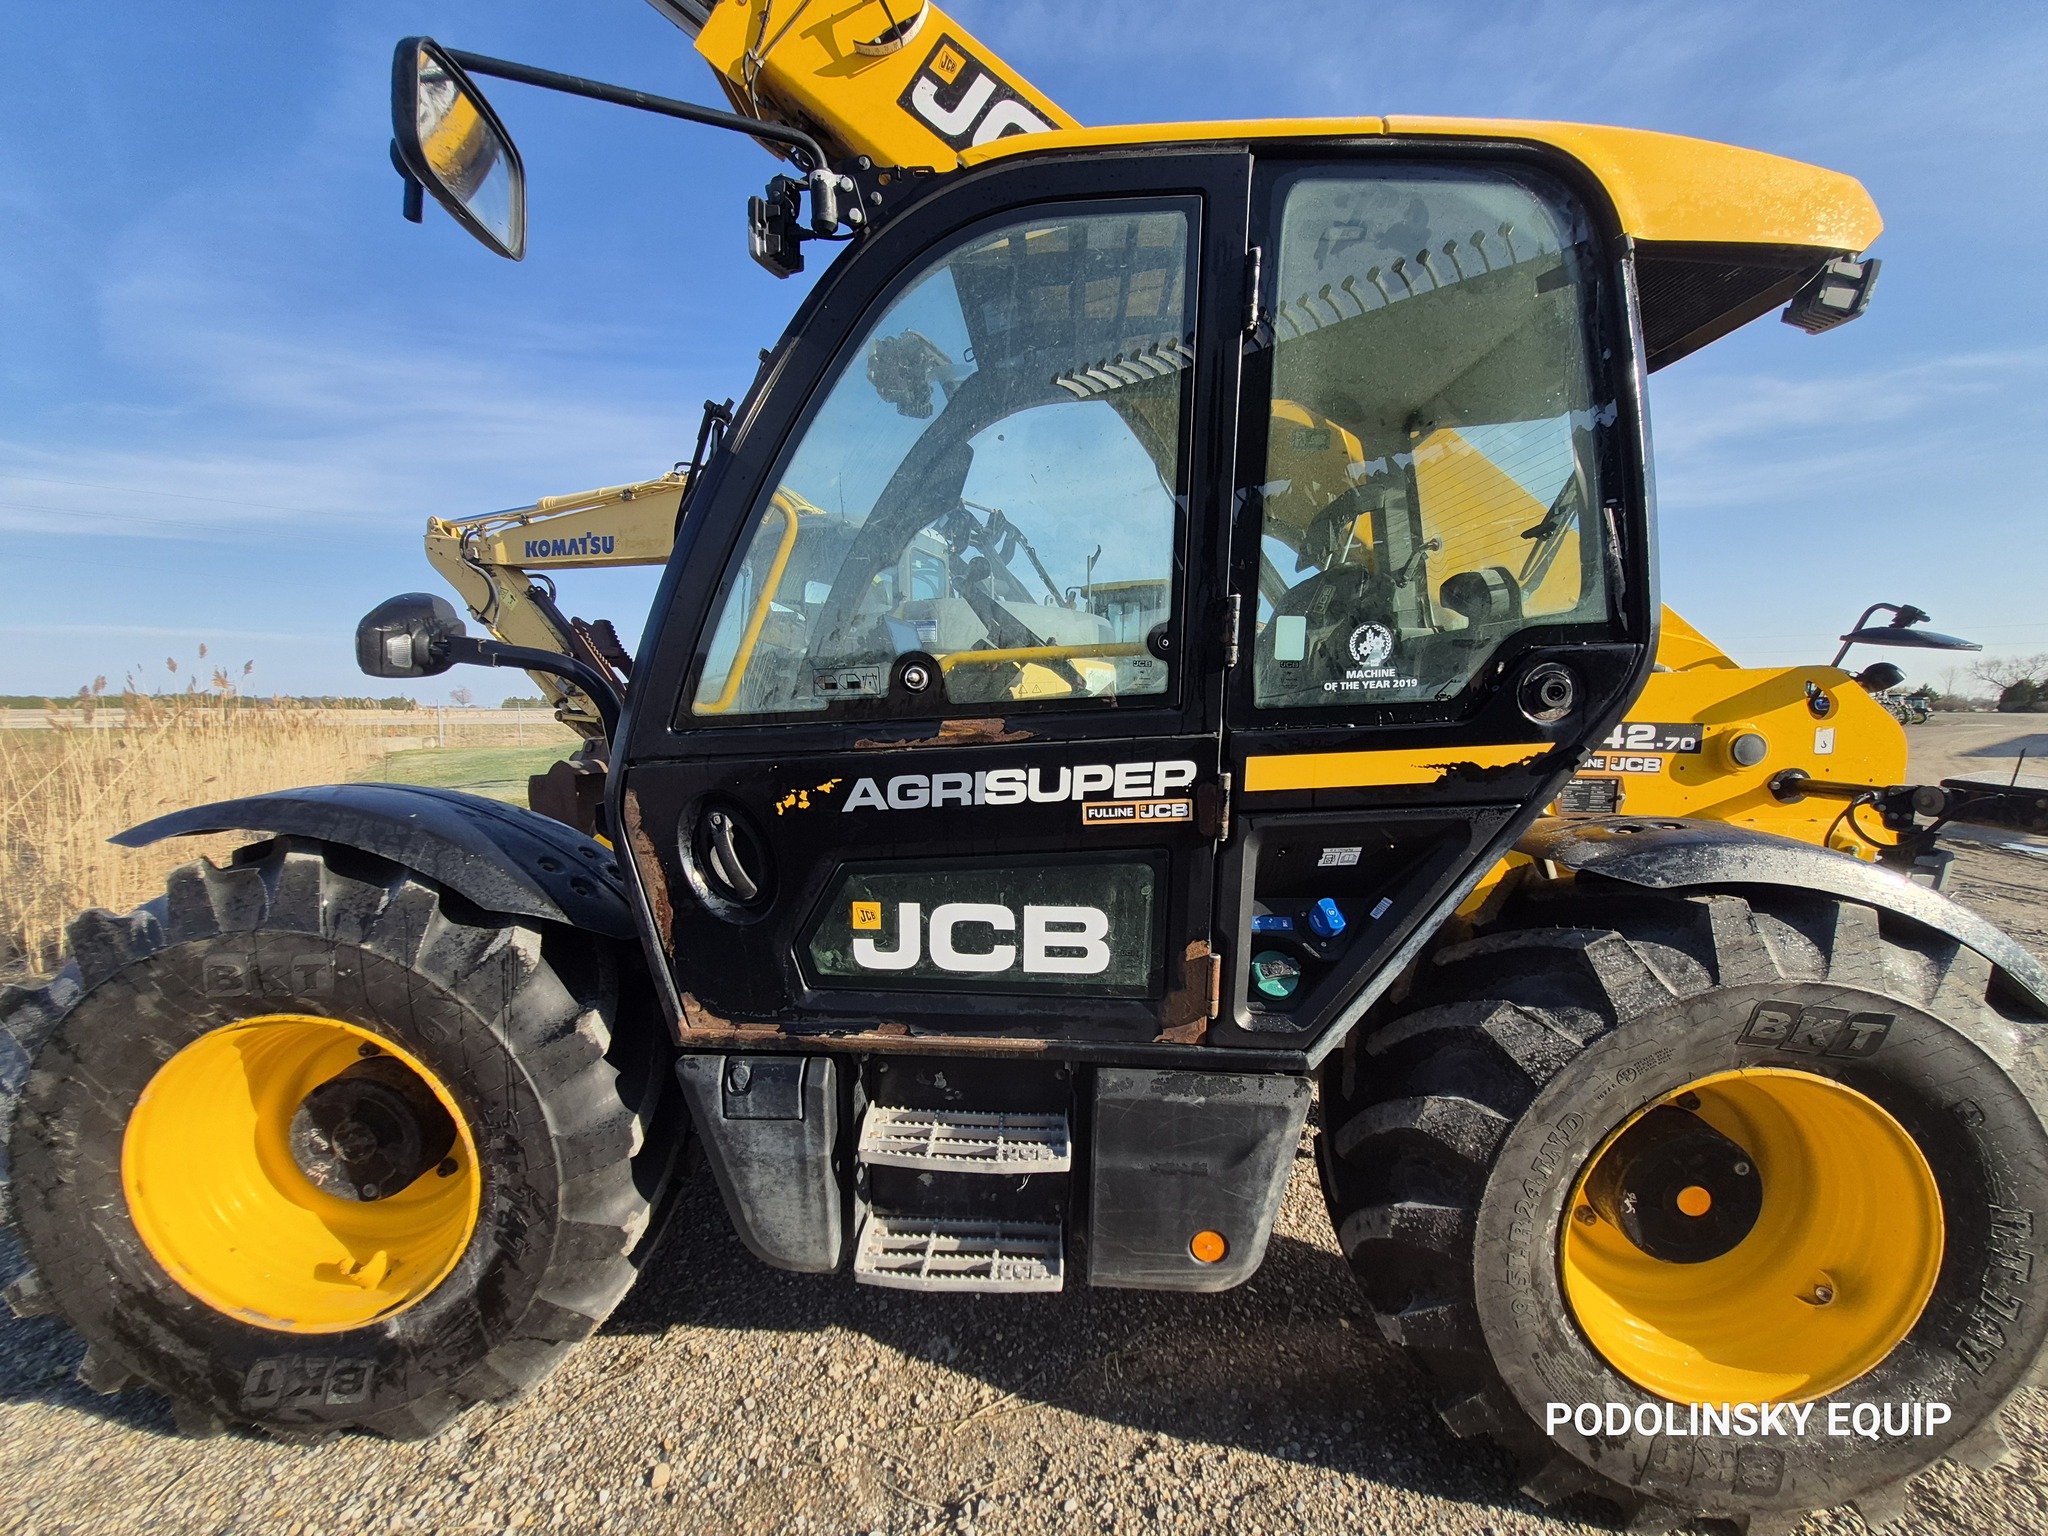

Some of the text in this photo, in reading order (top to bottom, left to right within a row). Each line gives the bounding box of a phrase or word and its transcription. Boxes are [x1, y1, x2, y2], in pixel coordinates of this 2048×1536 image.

[940, 54, 957, 72] JCB
[525, 532, 615, 558] KOMATSU
[1346, 668, 1396, 679] MACHINE
[1324, 678, 1417, 691] OF THE YEAR 2019
[1611, 757, 1661, 772] JCB
[1088, 807, 1134, 819] FULLINE
[1140, 803, 1188, 818] JCB
[860, 909, 876, 922] JCB
[853, 902, 1110, 973] JCB
[203, 957, 333, 994] BKT
[1744, 1006, 1889, 1053] BKT
[245, 1361, 371, 1402] BKT
